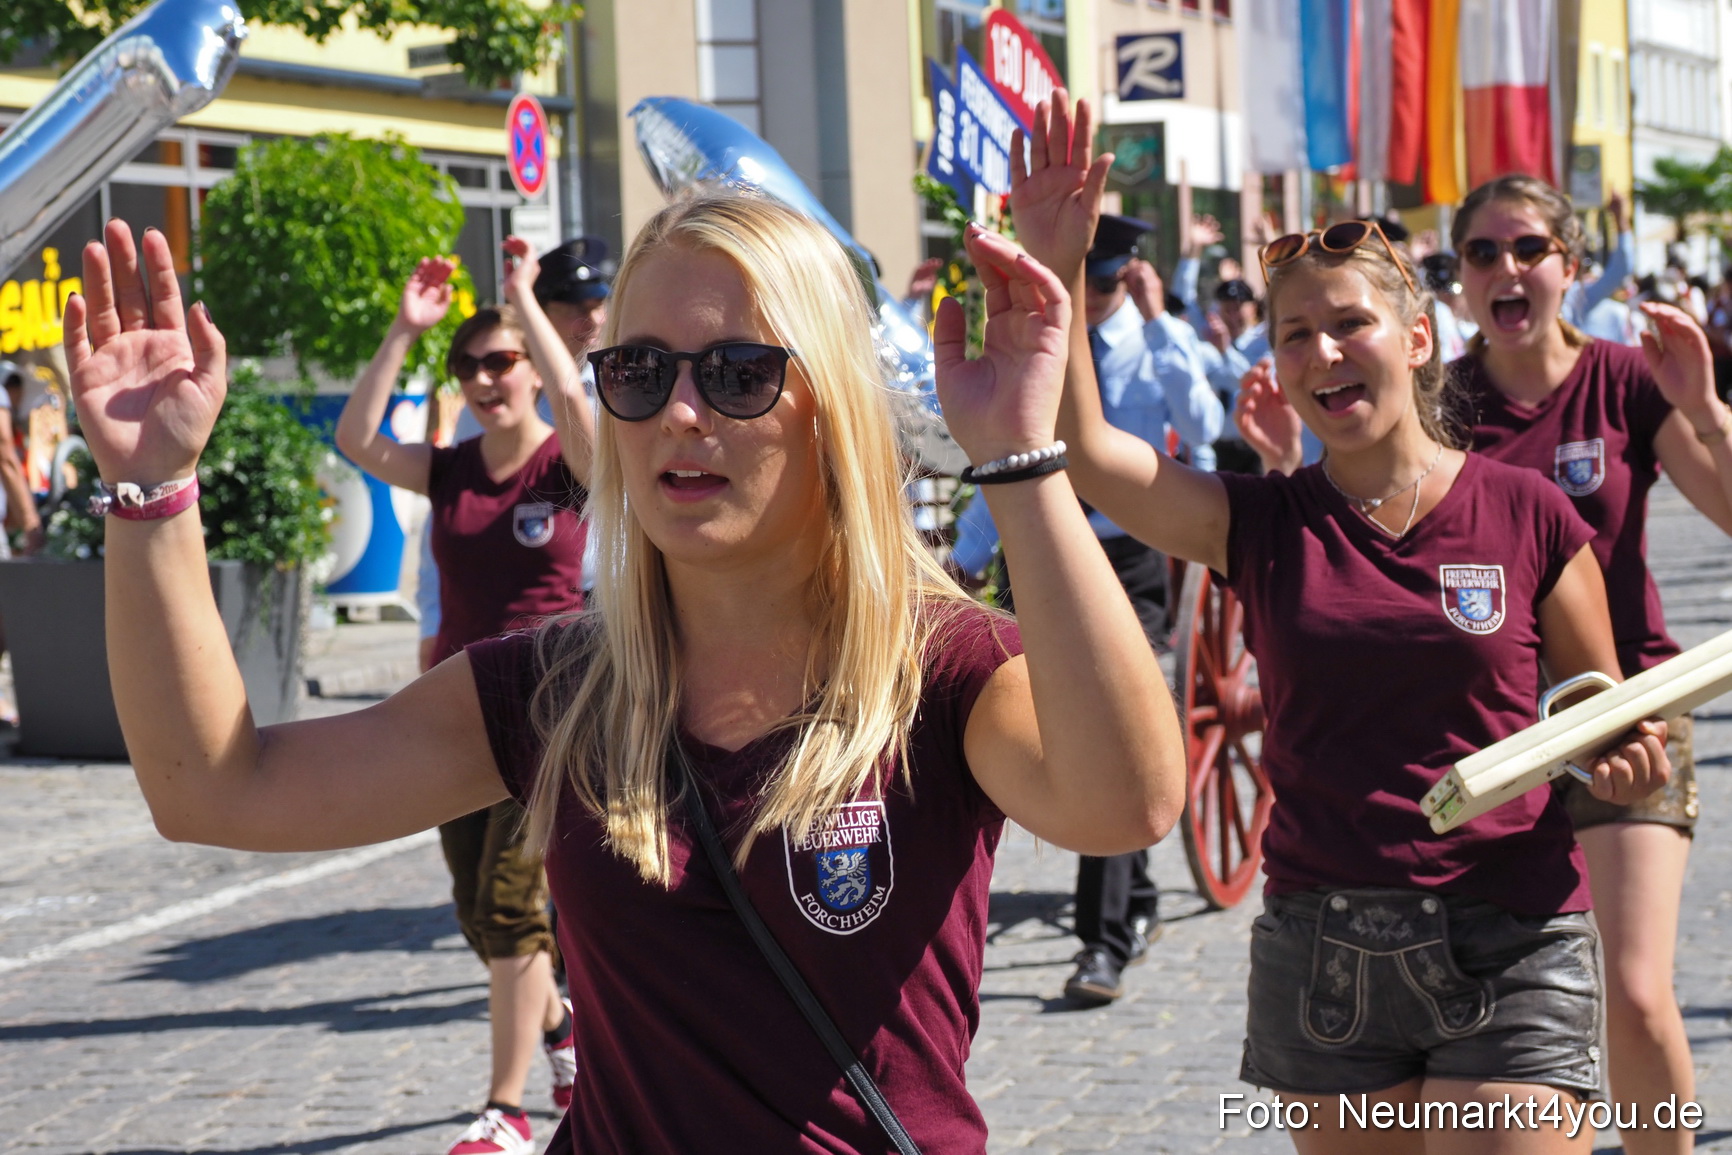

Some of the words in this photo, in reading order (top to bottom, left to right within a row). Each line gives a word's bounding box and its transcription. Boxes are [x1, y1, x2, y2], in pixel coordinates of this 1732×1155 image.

[990, 23, 1023, 94] 150
[1446, 579, 1499, 588] FEUERWEHR
[1449, 607, 1501, 630] FORCHHEIM
[801, 885, 885, 929] FORCHHEIM
